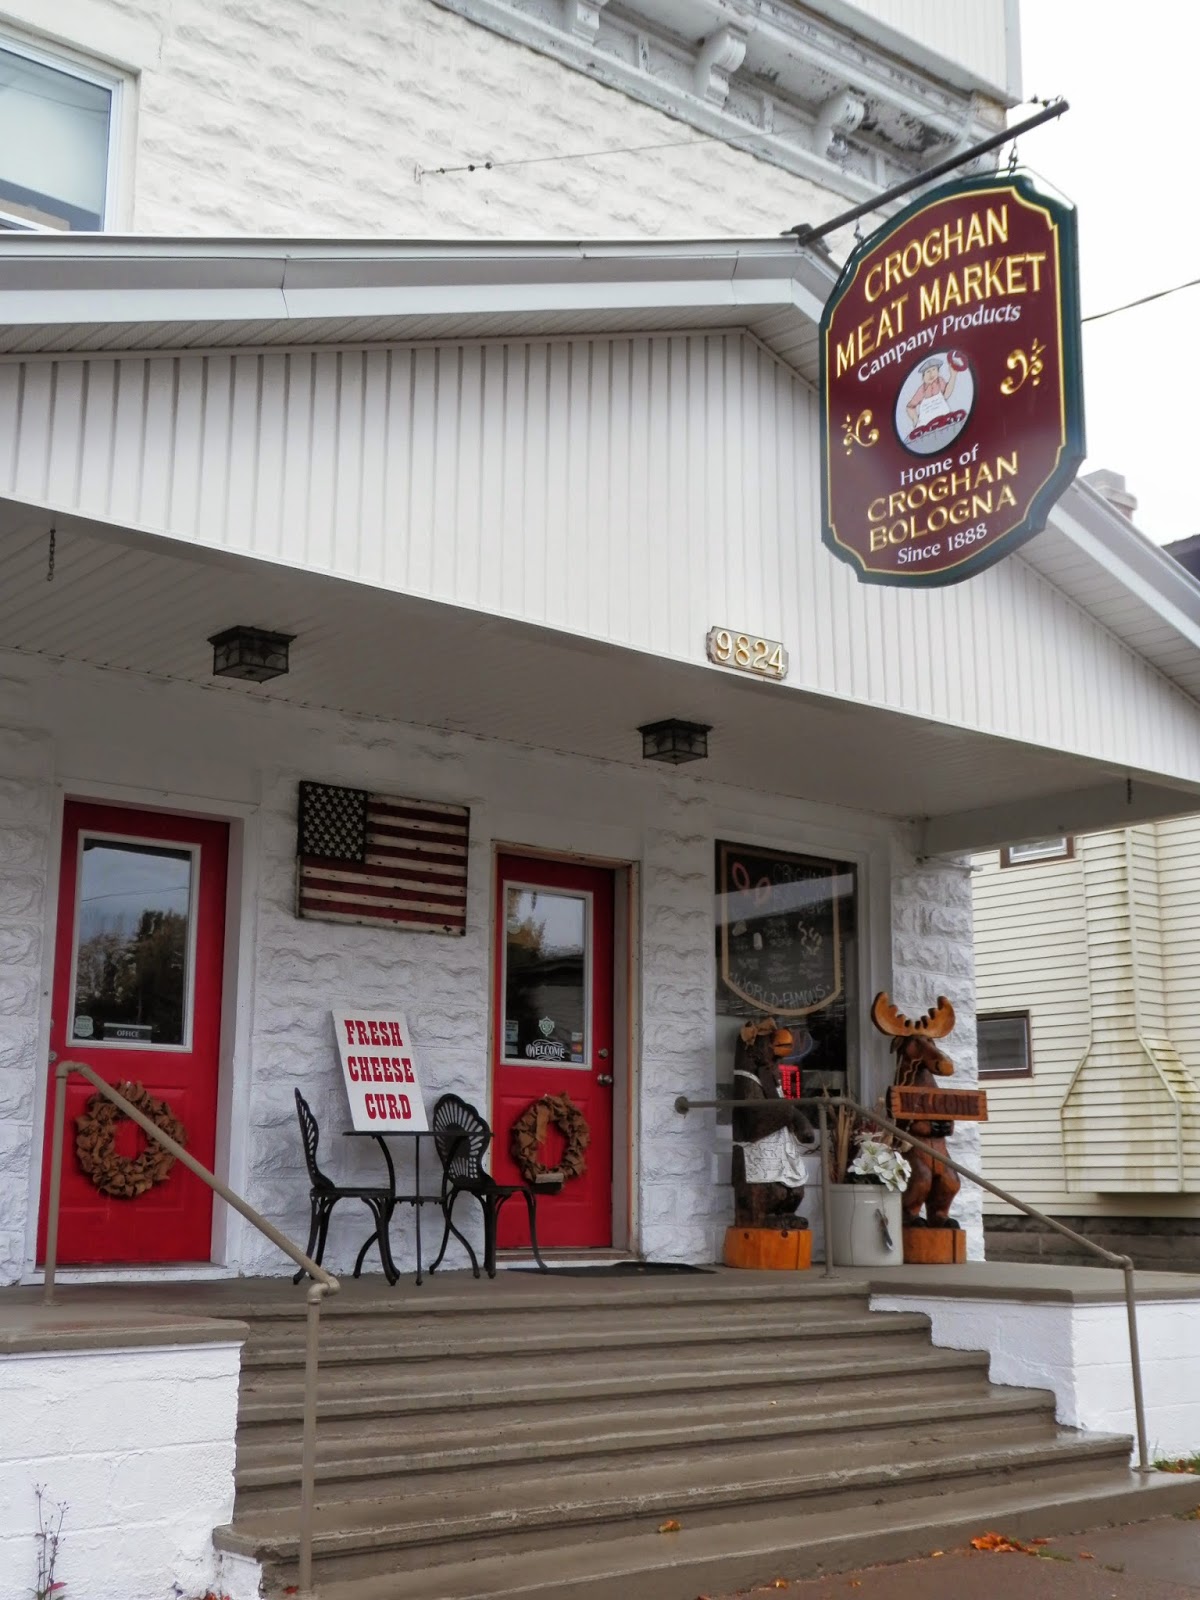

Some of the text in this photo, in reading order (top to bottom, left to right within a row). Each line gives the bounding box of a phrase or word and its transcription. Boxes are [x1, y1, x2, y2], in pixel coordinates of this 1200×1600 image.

[864, 204, 1008, 303] CROGHAN
[836, 251, 1047, 379] MEAT MARKET
[942, 303, 1022, 337] Products
[900, 444, 980, 486] Home of
[867, 451, 1018, 523] CROGHAN
[869, 484, 1018, 552] BOLOGNA
[897, 522, 988, 565] Since 1888
[716, 631, 785, 675] 9824
[116, 1029, 139, 1038] OFFICE
[344, 1020, 403, 1046] FRESH
[525, 1043, 565, 1059] WELCOME
[347, 1056, 415, 1083] CHEESE
[364, 1093, 412, 1120] CURD
